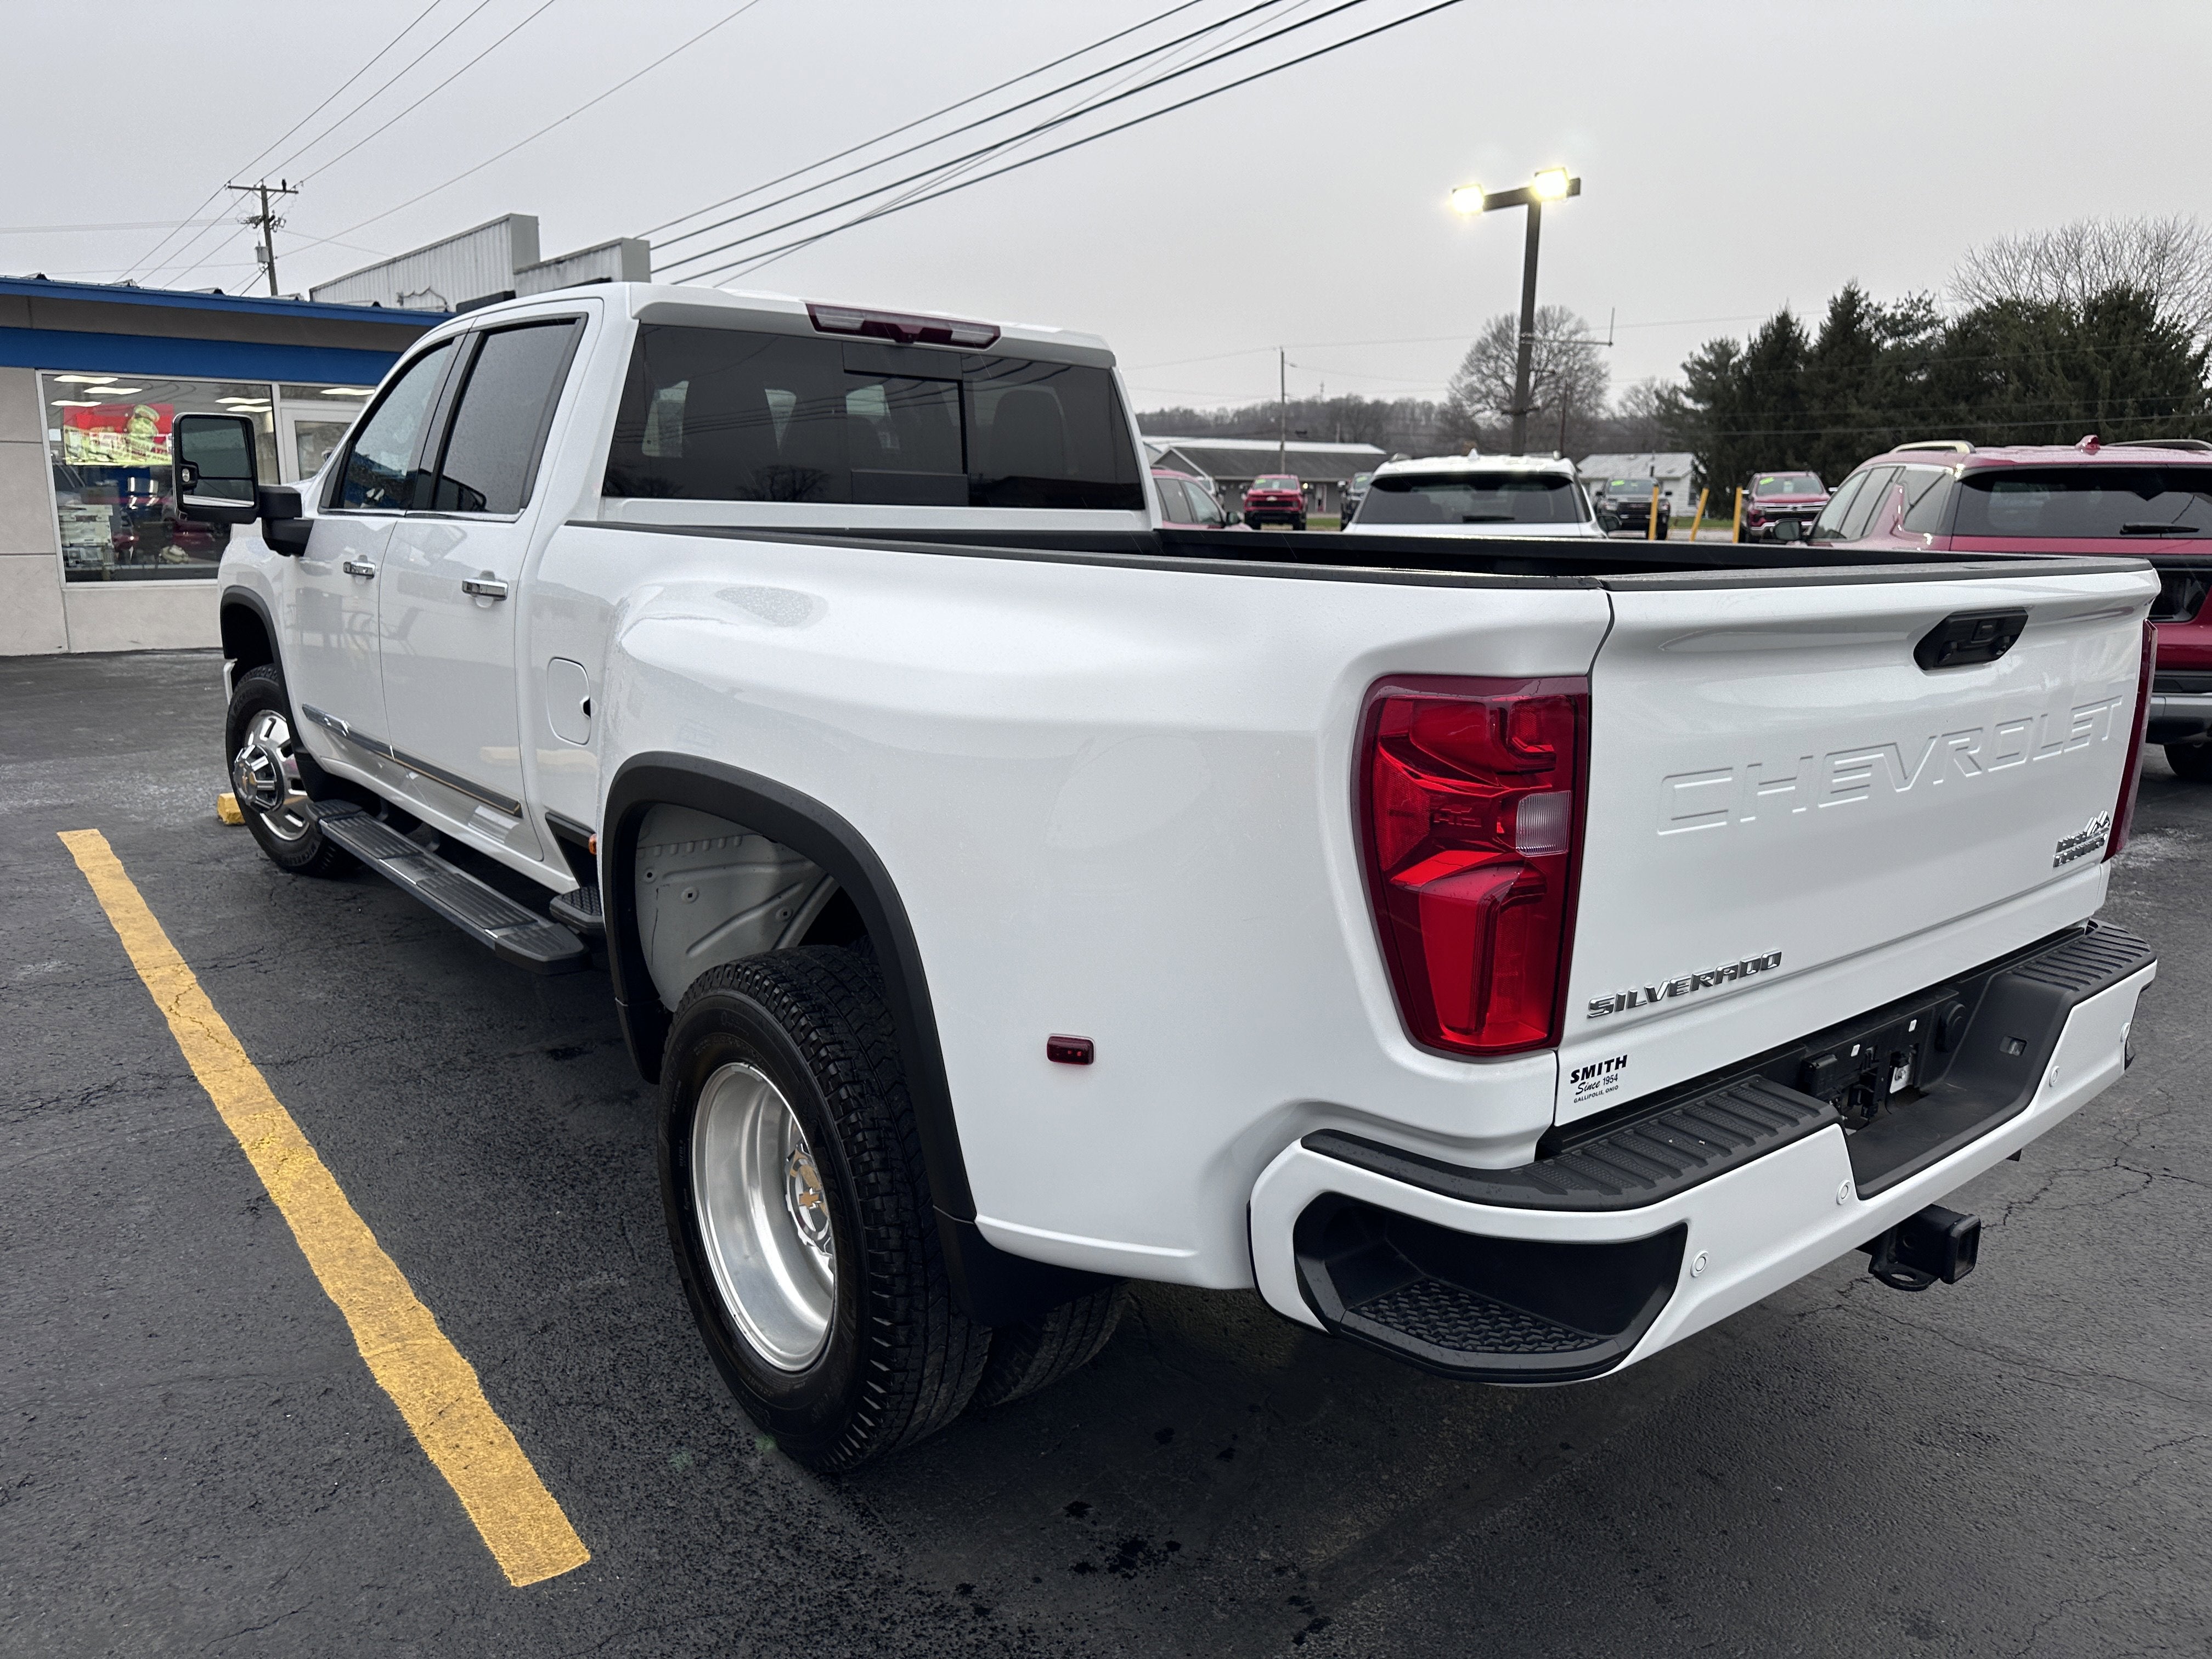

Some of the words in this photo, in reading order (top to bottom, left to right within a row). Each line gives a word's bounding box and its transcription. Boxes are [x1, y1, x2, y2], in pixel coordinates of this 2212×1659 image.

[1657, 695, 2124, 836] CHEVROLET
[1433, 812, 1482, 827] HD
[1587, 949, 1782, 1019] SILVERADO
[1570, 1054, 1628, 1084] SMITH
[1573, 1090, 1604, 1103] GALLIPOLIS,
[1605, 1085, 1618, 1093] OHIO
[1575, 1080, 1601, 1096] Since
[1602, 1073, 1618, 1086] 1954
